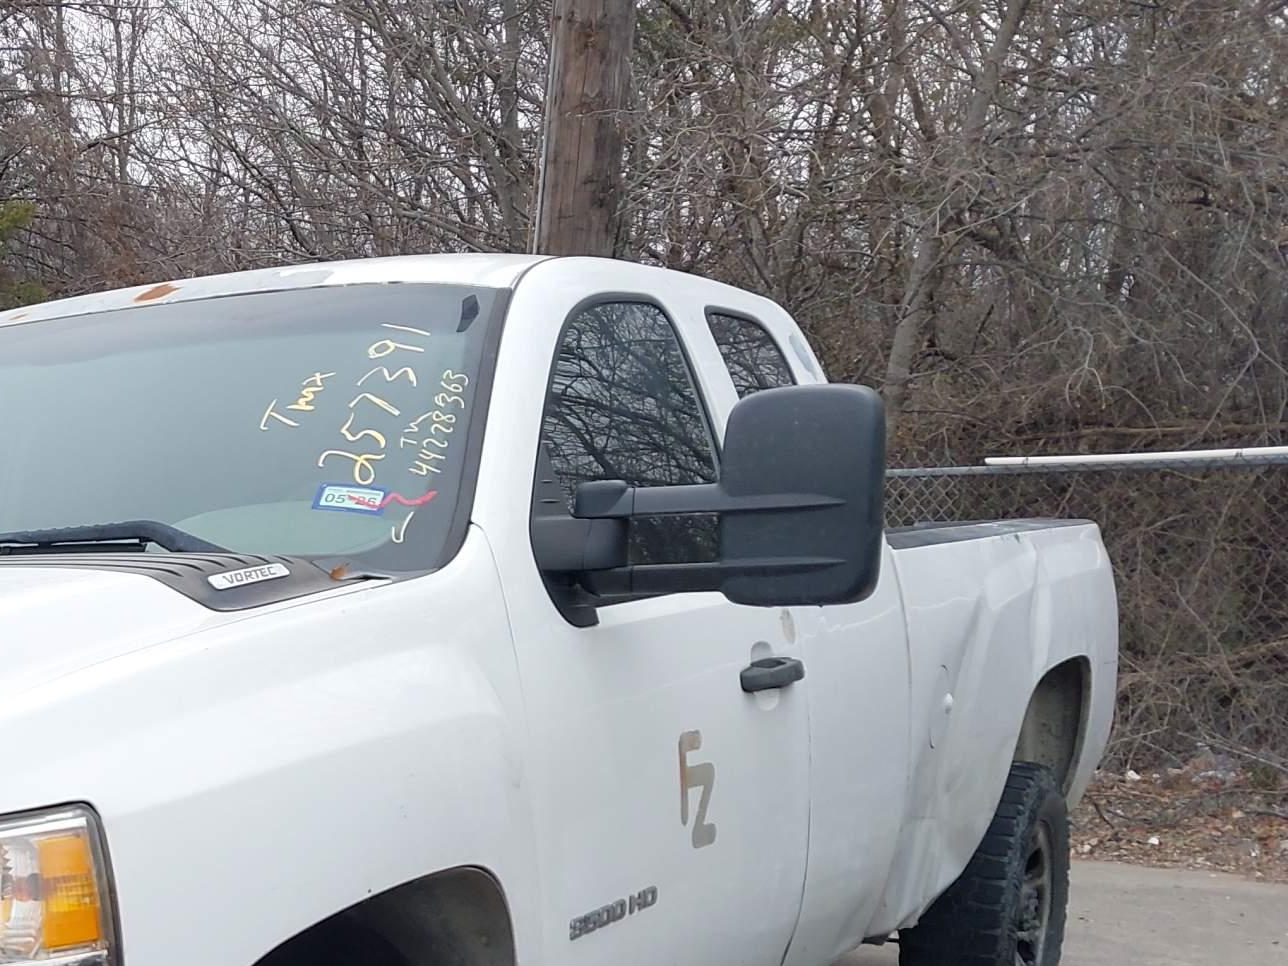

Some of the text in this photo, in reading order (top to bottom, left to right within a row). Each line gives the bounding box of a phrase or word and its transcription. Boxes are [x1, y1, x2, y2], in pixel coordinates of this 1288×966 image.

[408, 369, 470, 476] 44228363
[222, 566, 277, 585] VORTEC
[628, 885, 658, 915] HD
